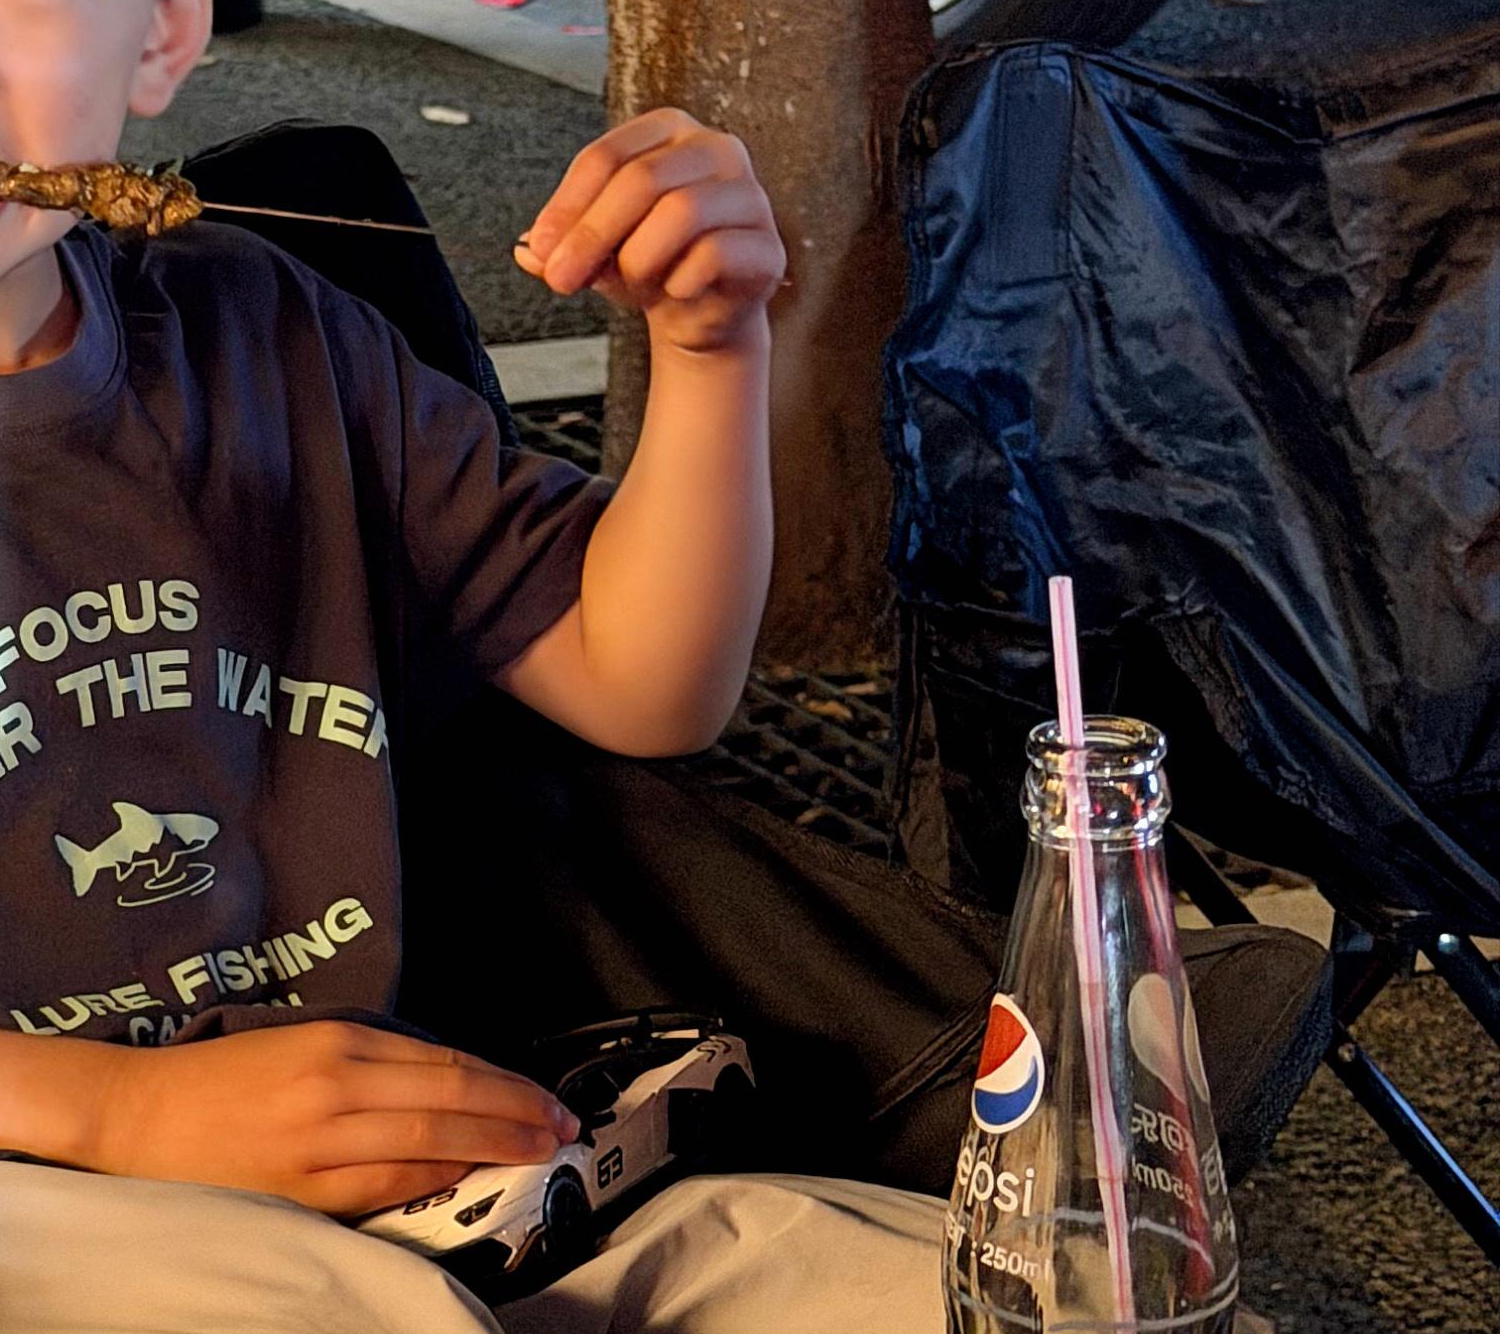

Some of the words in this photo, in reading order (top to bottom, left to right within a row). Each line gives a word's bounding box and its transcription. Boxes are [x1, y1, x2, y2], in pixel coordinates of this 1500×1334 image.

[55, 648, 193, 727] THE
[10, 983, 165, 1036] LURE
[167, 897, 374, 1005] FISHING
